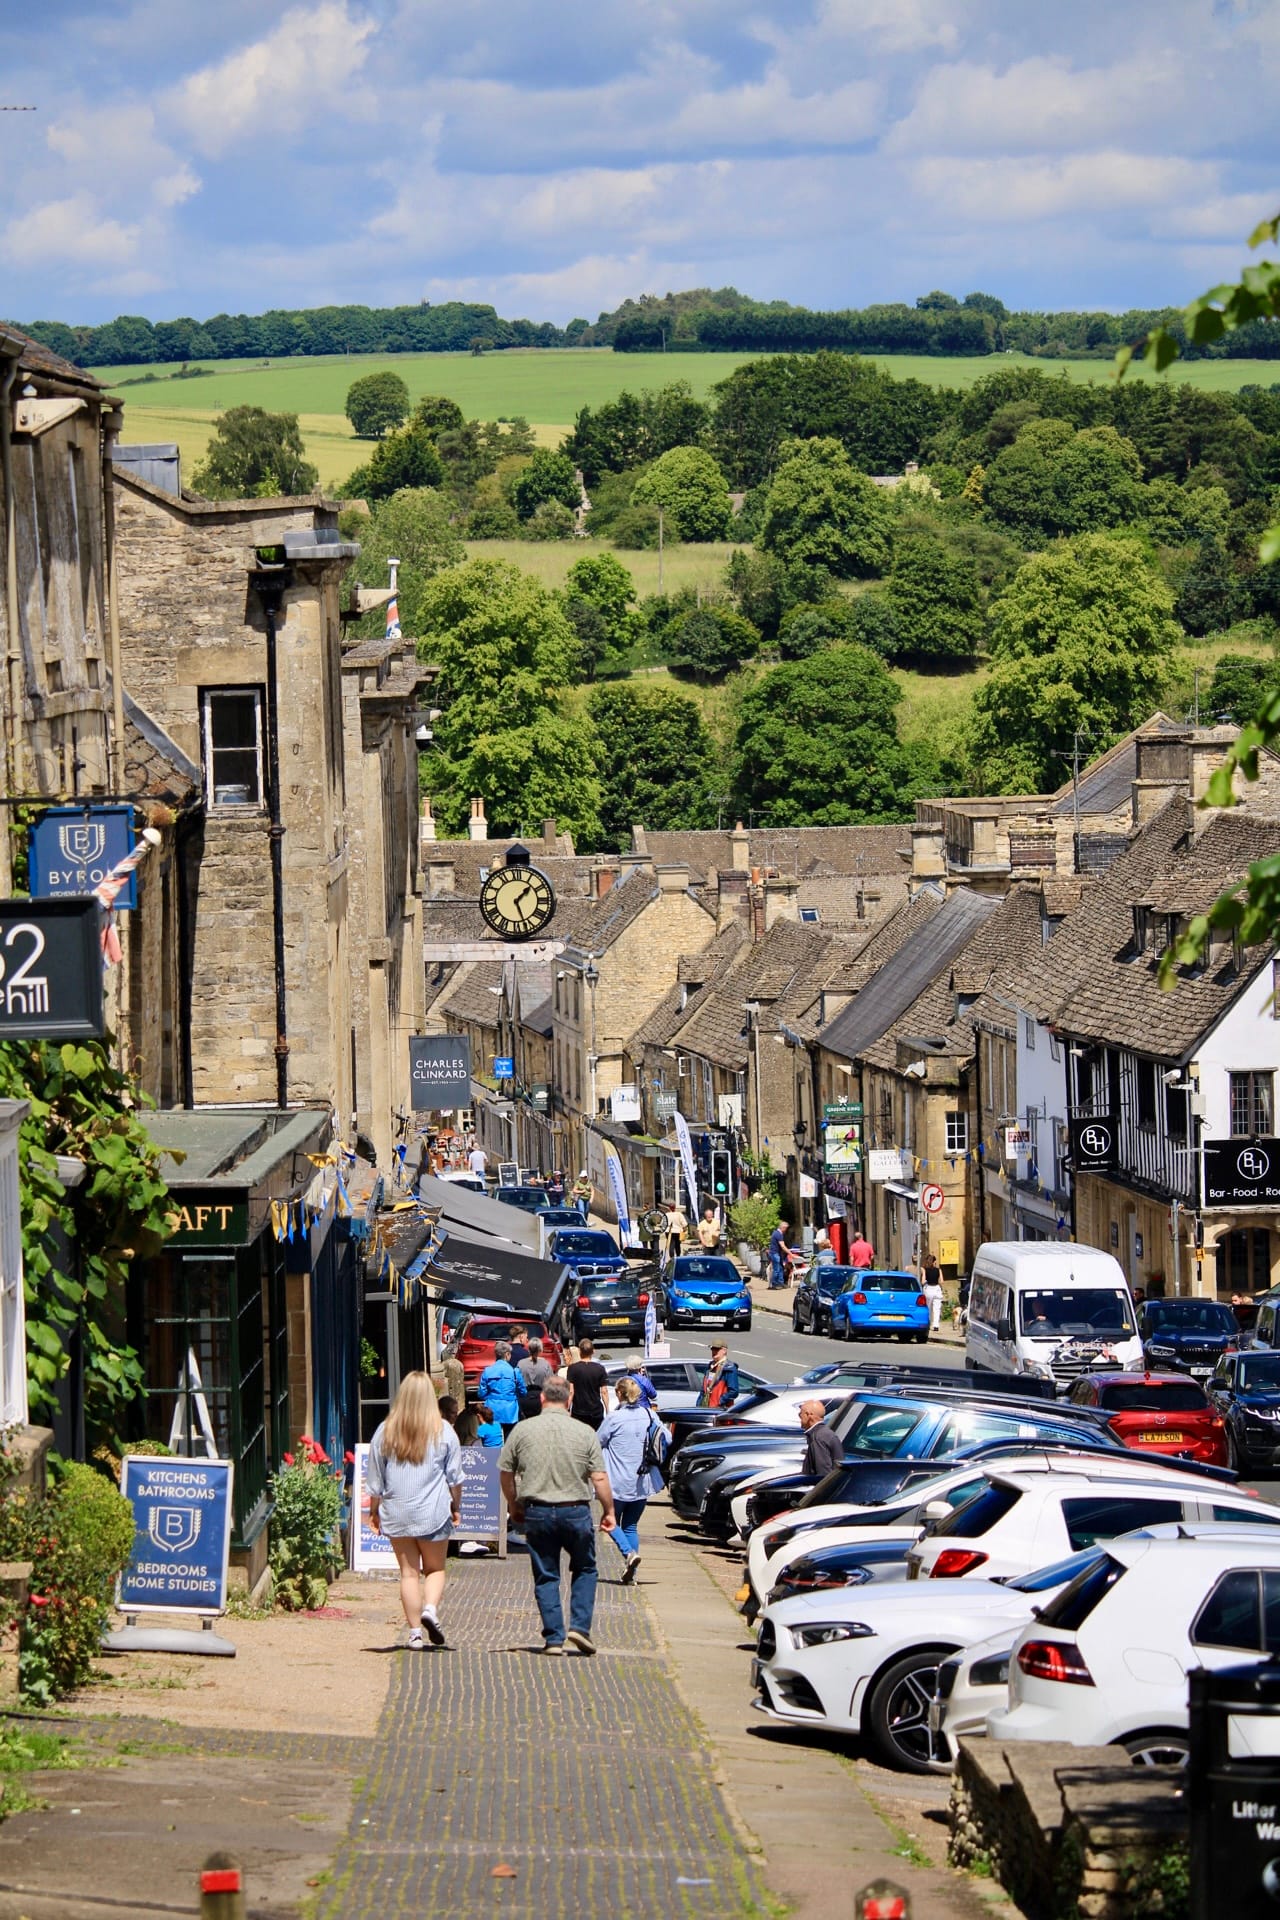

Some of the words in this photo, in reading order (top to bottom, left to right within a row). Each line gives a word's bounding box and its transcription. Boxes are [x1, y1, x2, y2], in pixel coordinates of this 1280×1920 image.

[49, 869, 109, 885] BYRO
[0, 923, 48, 986] 2
[0, 983, 49, 1014] hill
[415, 1059, 464, 1069] CHARLES
[412, 1069, 467, 1079] CLINKARD
[1209, 1188, 1226, 1198] Bar
[1233, 1187, 1258, 1197] Food
[177, 1206, 233, 1231] AFT
[148, 1471, 207, 1485] KITCHENS
[463, 1473, 489, 1483] eaway
[137, 1484, 216, 1500] BATHROOMS
[137, 1562, 208, 1577] BEDROOMS
[126, 1577, 165, 1590] HOME
[167, 1578, 217, 1592] STUDIES
